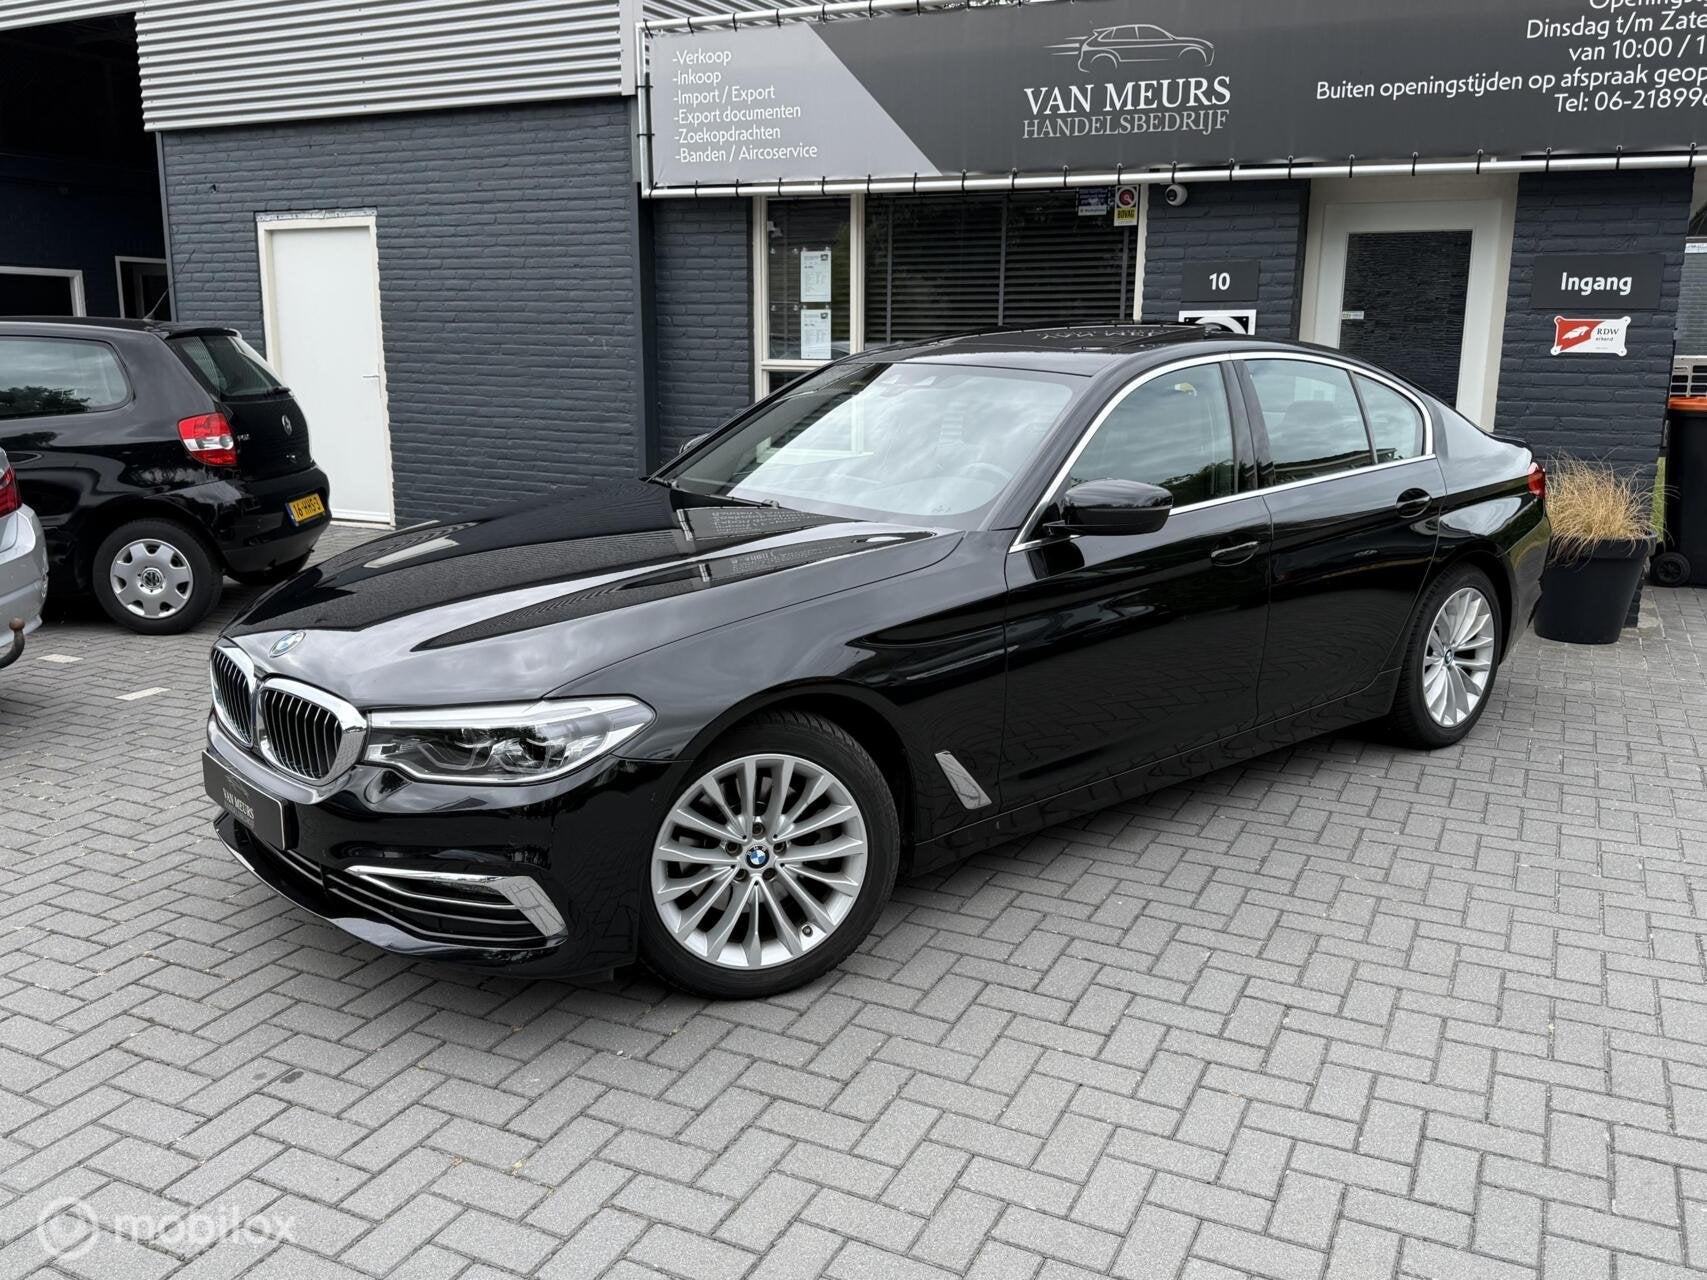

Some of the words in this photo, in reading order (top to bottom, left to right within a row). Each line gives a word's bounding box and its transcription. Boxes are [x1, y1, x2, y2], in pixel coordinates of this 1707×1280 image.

[1526, 15, 1610, 40] Dinsdag
[1616, 11, 1653, 35] t/m
[1660, 10, 1707, 31] Zate
[672, 47, 732, 66] -Verkoop
[1568, 46, 1605, 61] van
[1612, 37, 1673, 59] 10:00
[1677, 33, 1692, 58] /
[672, 68, 722, 86] -Inkoop
[1316, 80, 1375, 99] Buiten
[1379, 71, 1523, 101] openingstijden
[1528, 74, 1556, 94] op
[1560, 64, 1649, 91] afspraak
[1654, 67, 1707, 88] geop
[673, 89, 720, 107] -Import
[722, 85, 729, 104] /
[731, 84, 776, 105] Export
[1023, 84, 1095, 116] VAN
[1103, 76, 1231, 112] MEURS
[1554, 91, 1589, 113] Tel:
[673, 108, 720, 127] -Export
[723, 104, 801, 122] documenten
[1022, 109, 1230, 139] HANDELSBEDRIJF
[673, 124, 781, 145] -Zoekopdrachten
[674, 146, 726, 162] -Banden
[728, 144, 736, 162] /
[738, 142, 818, 160] Aircoservice
[1209, 272, 1231, 291] 10
[1560, 271, 1633, 296] Ingang
[1596, 327, 1620, 336] RDW
